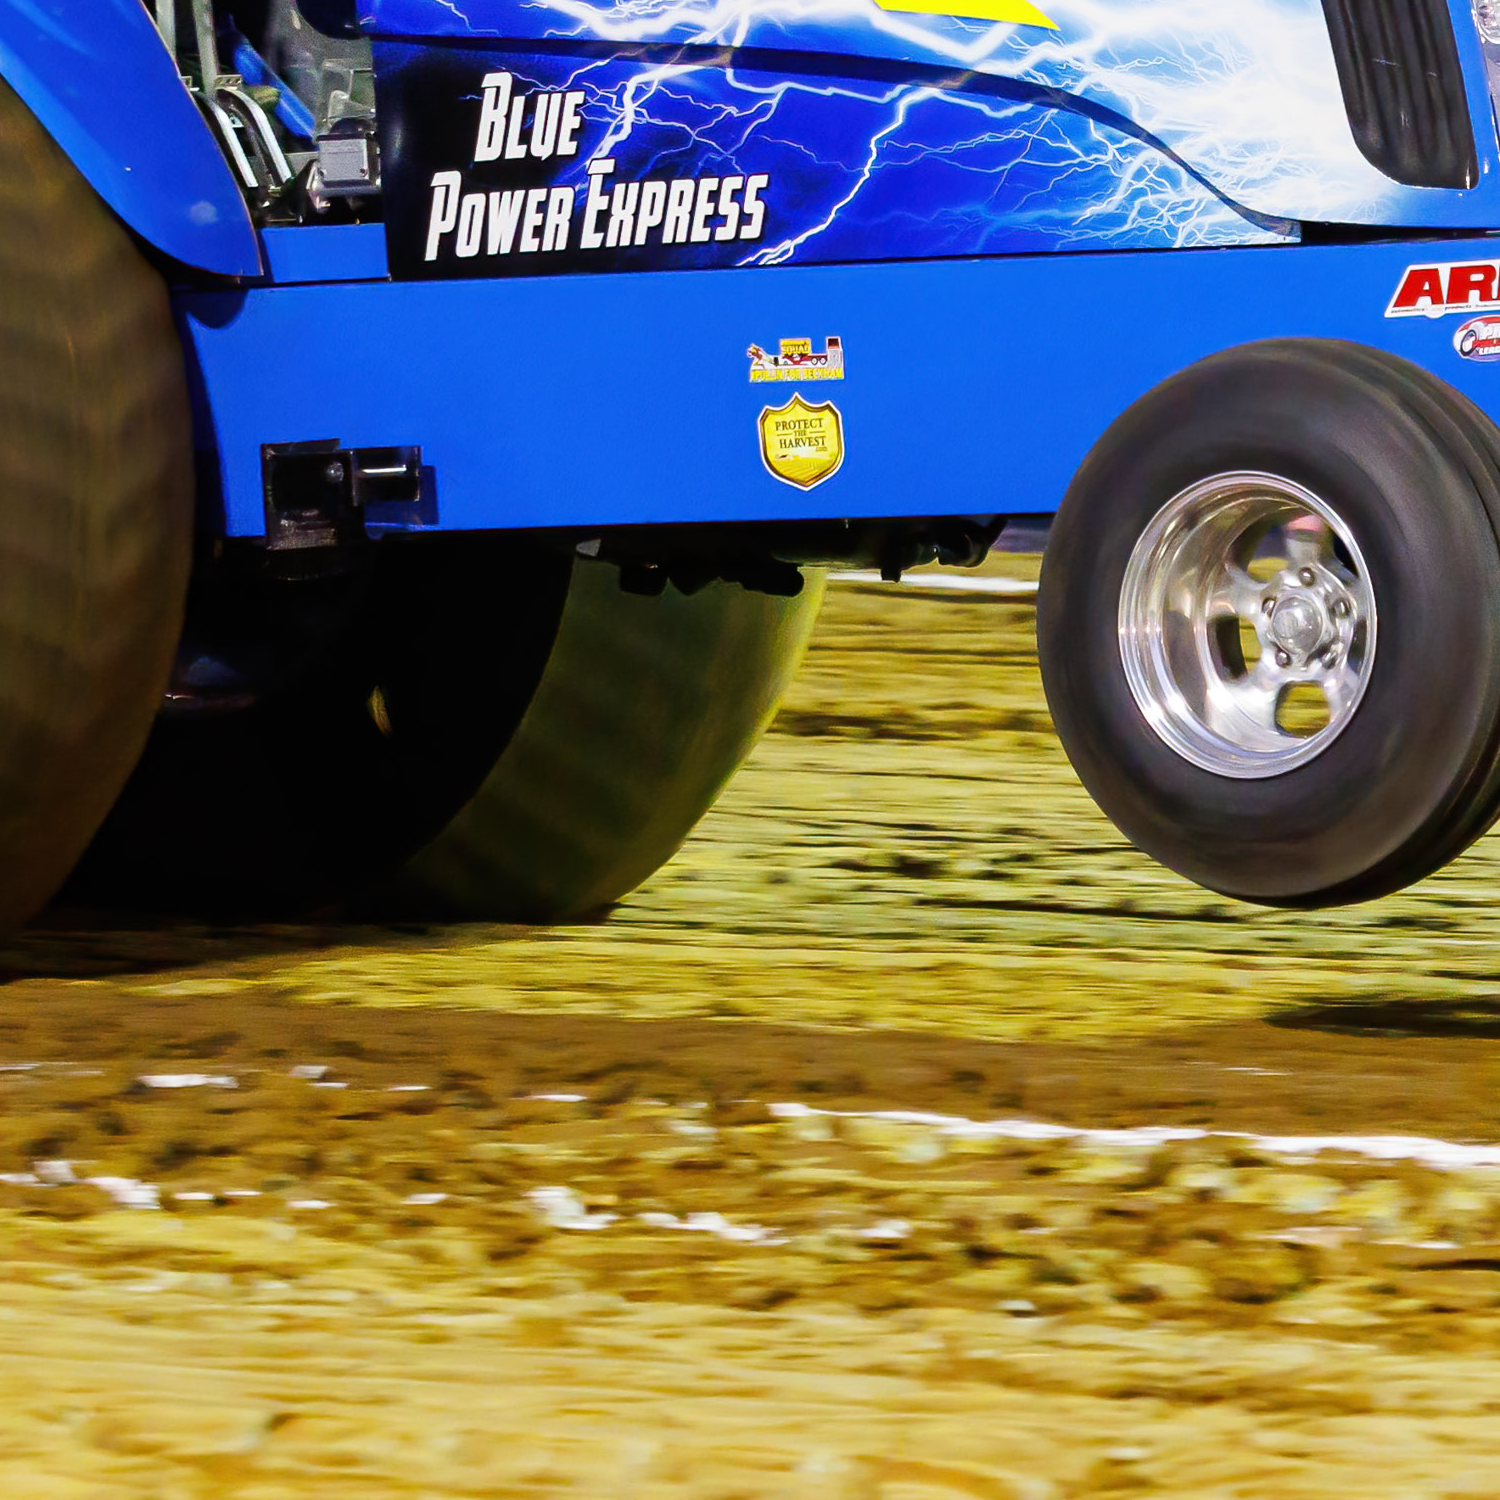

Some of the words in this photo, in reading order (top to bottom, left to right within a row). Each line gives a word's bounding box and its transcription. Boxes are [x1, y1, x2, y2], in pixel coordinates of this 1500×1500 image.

[474, 71, 586, 162] BLUE
[424, 170, 575, 261] POWER
[580, 158, 769, 249] EXPRESS
[775, 418, 824, 431] PROTECT
[779, 436, 827, 449] HARVEST
